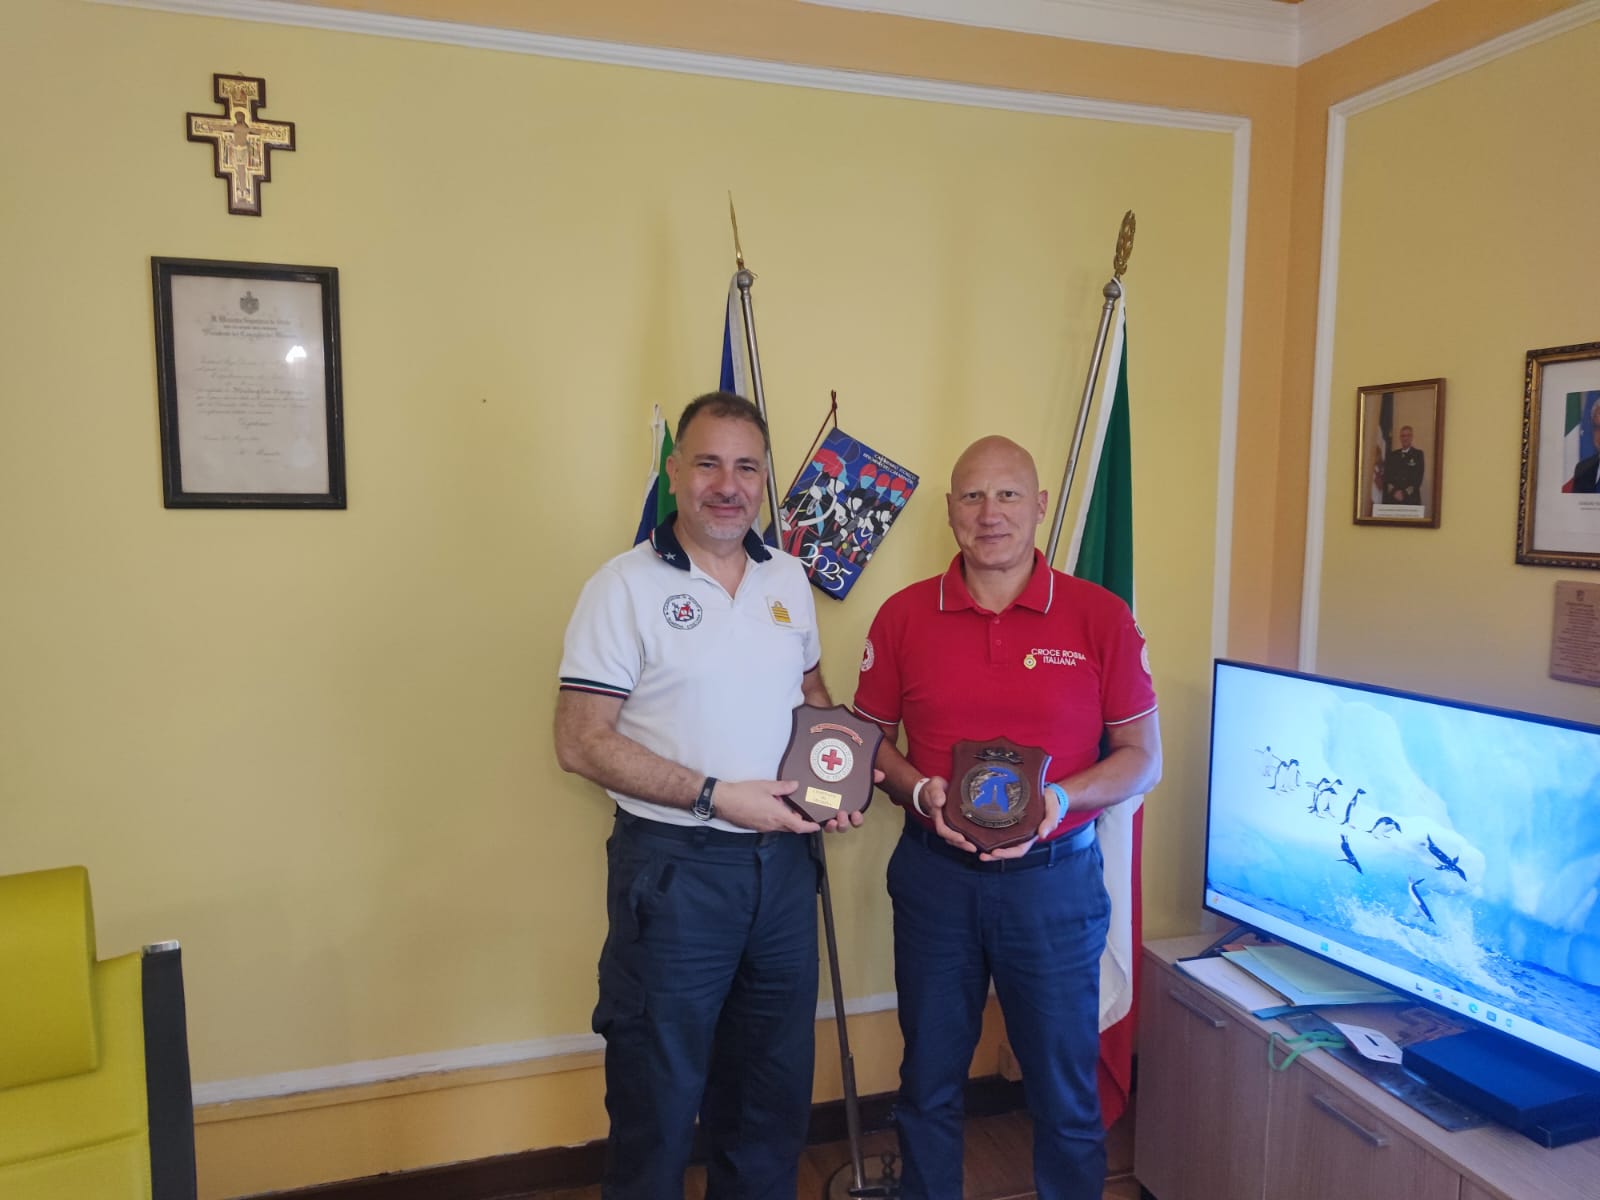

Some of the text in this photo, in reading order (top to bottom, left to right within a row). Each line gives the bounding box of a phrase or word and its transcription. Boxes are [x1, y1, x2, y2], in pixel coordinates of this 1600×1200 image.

[800, 543, 853, 591] 2025
[1031, 648, 1086, 661] CROCE ROSSA
[1043, 656, 1076, 666] ITALIANA
